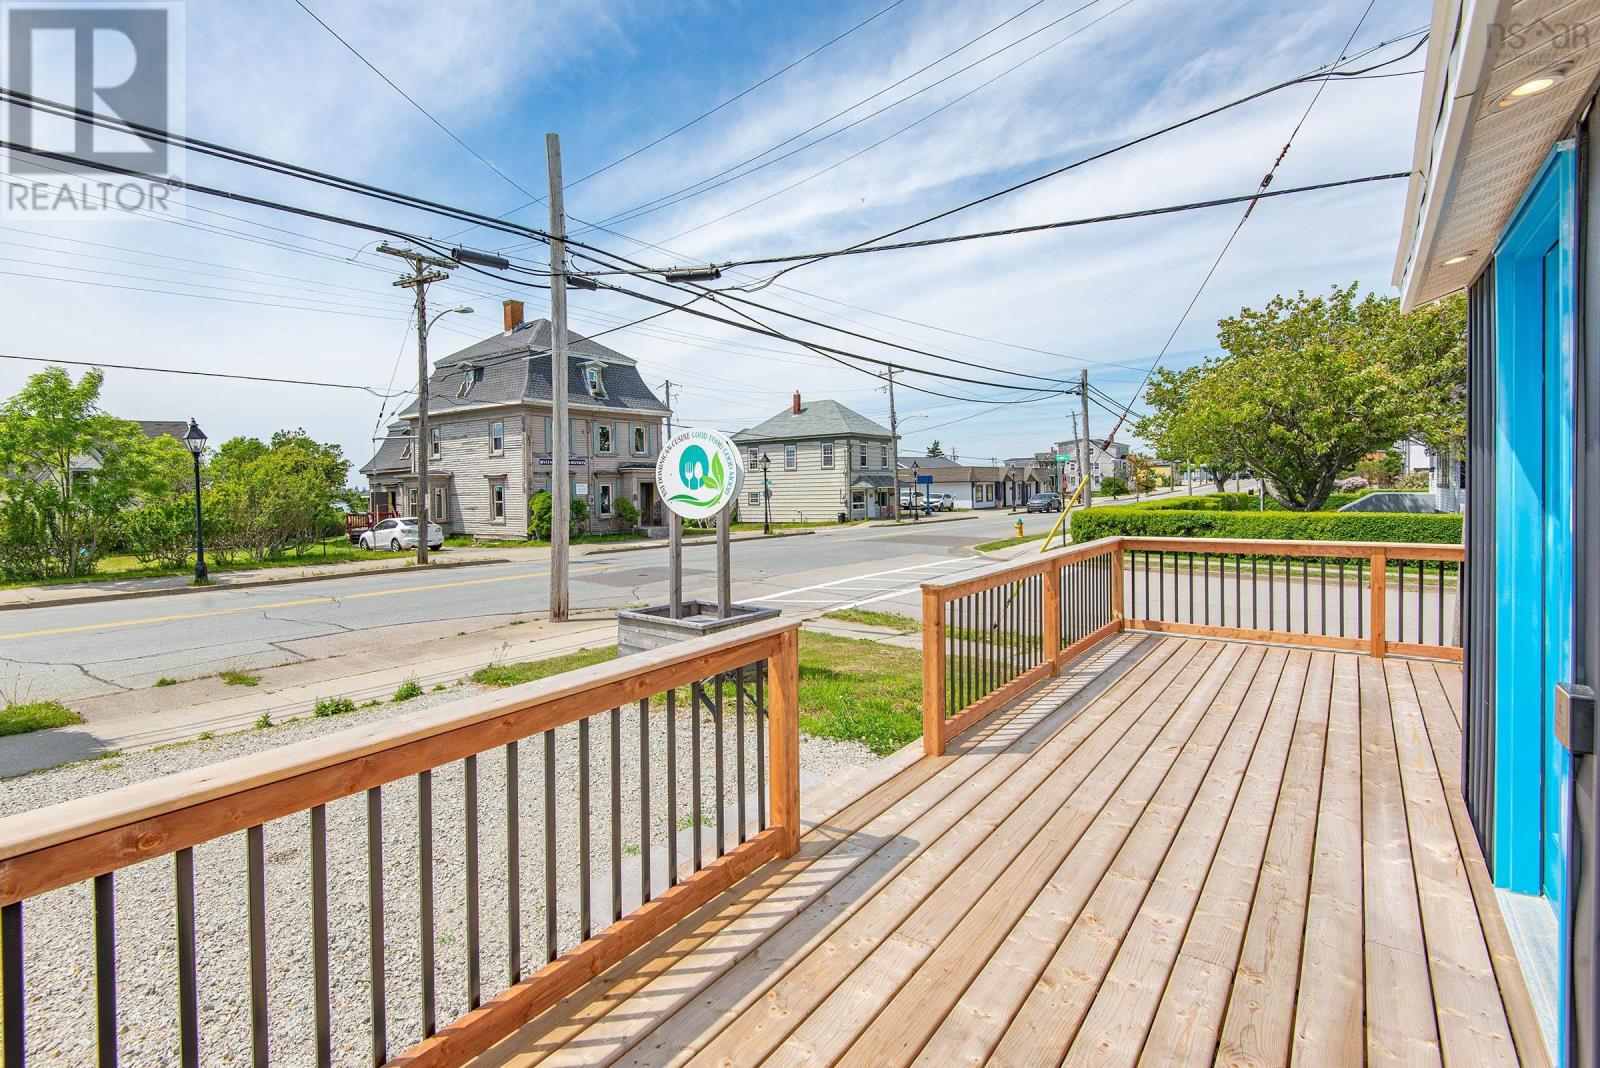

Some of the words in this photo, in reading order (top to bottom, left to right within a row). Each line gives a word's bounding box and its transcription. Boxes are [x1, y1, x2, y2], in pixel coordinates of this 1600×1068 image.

[691, 431, 708, 439] GOOD
[708, 434, 724, 449] FOOD
[657, 445, 672, 485] DOMINICAN
[722, 448, 734, 469] GOOD
[724, 471, 734, 495] MOOD
